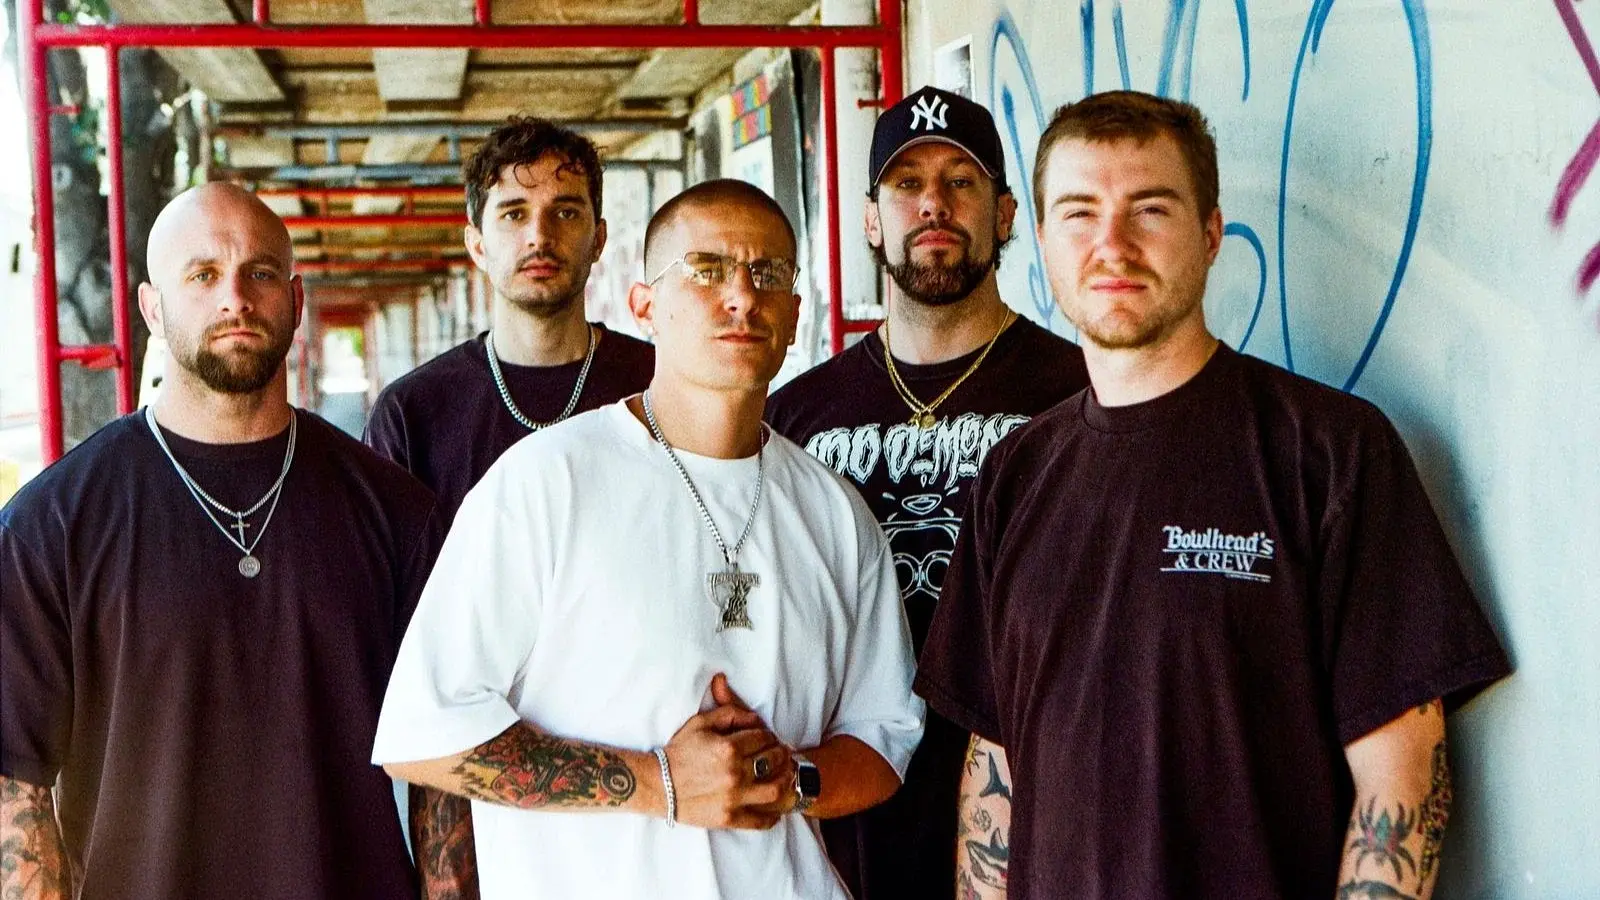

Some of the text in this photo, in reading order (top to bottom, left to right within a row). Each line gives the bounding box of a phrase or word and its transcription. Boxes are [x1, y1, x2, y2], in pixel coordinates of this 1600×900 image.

[910, 95, 949, 131] NY
[1162, 525, 1274, 555] Bowlhead's
[1174, 551, 1257, 572] & CREW
